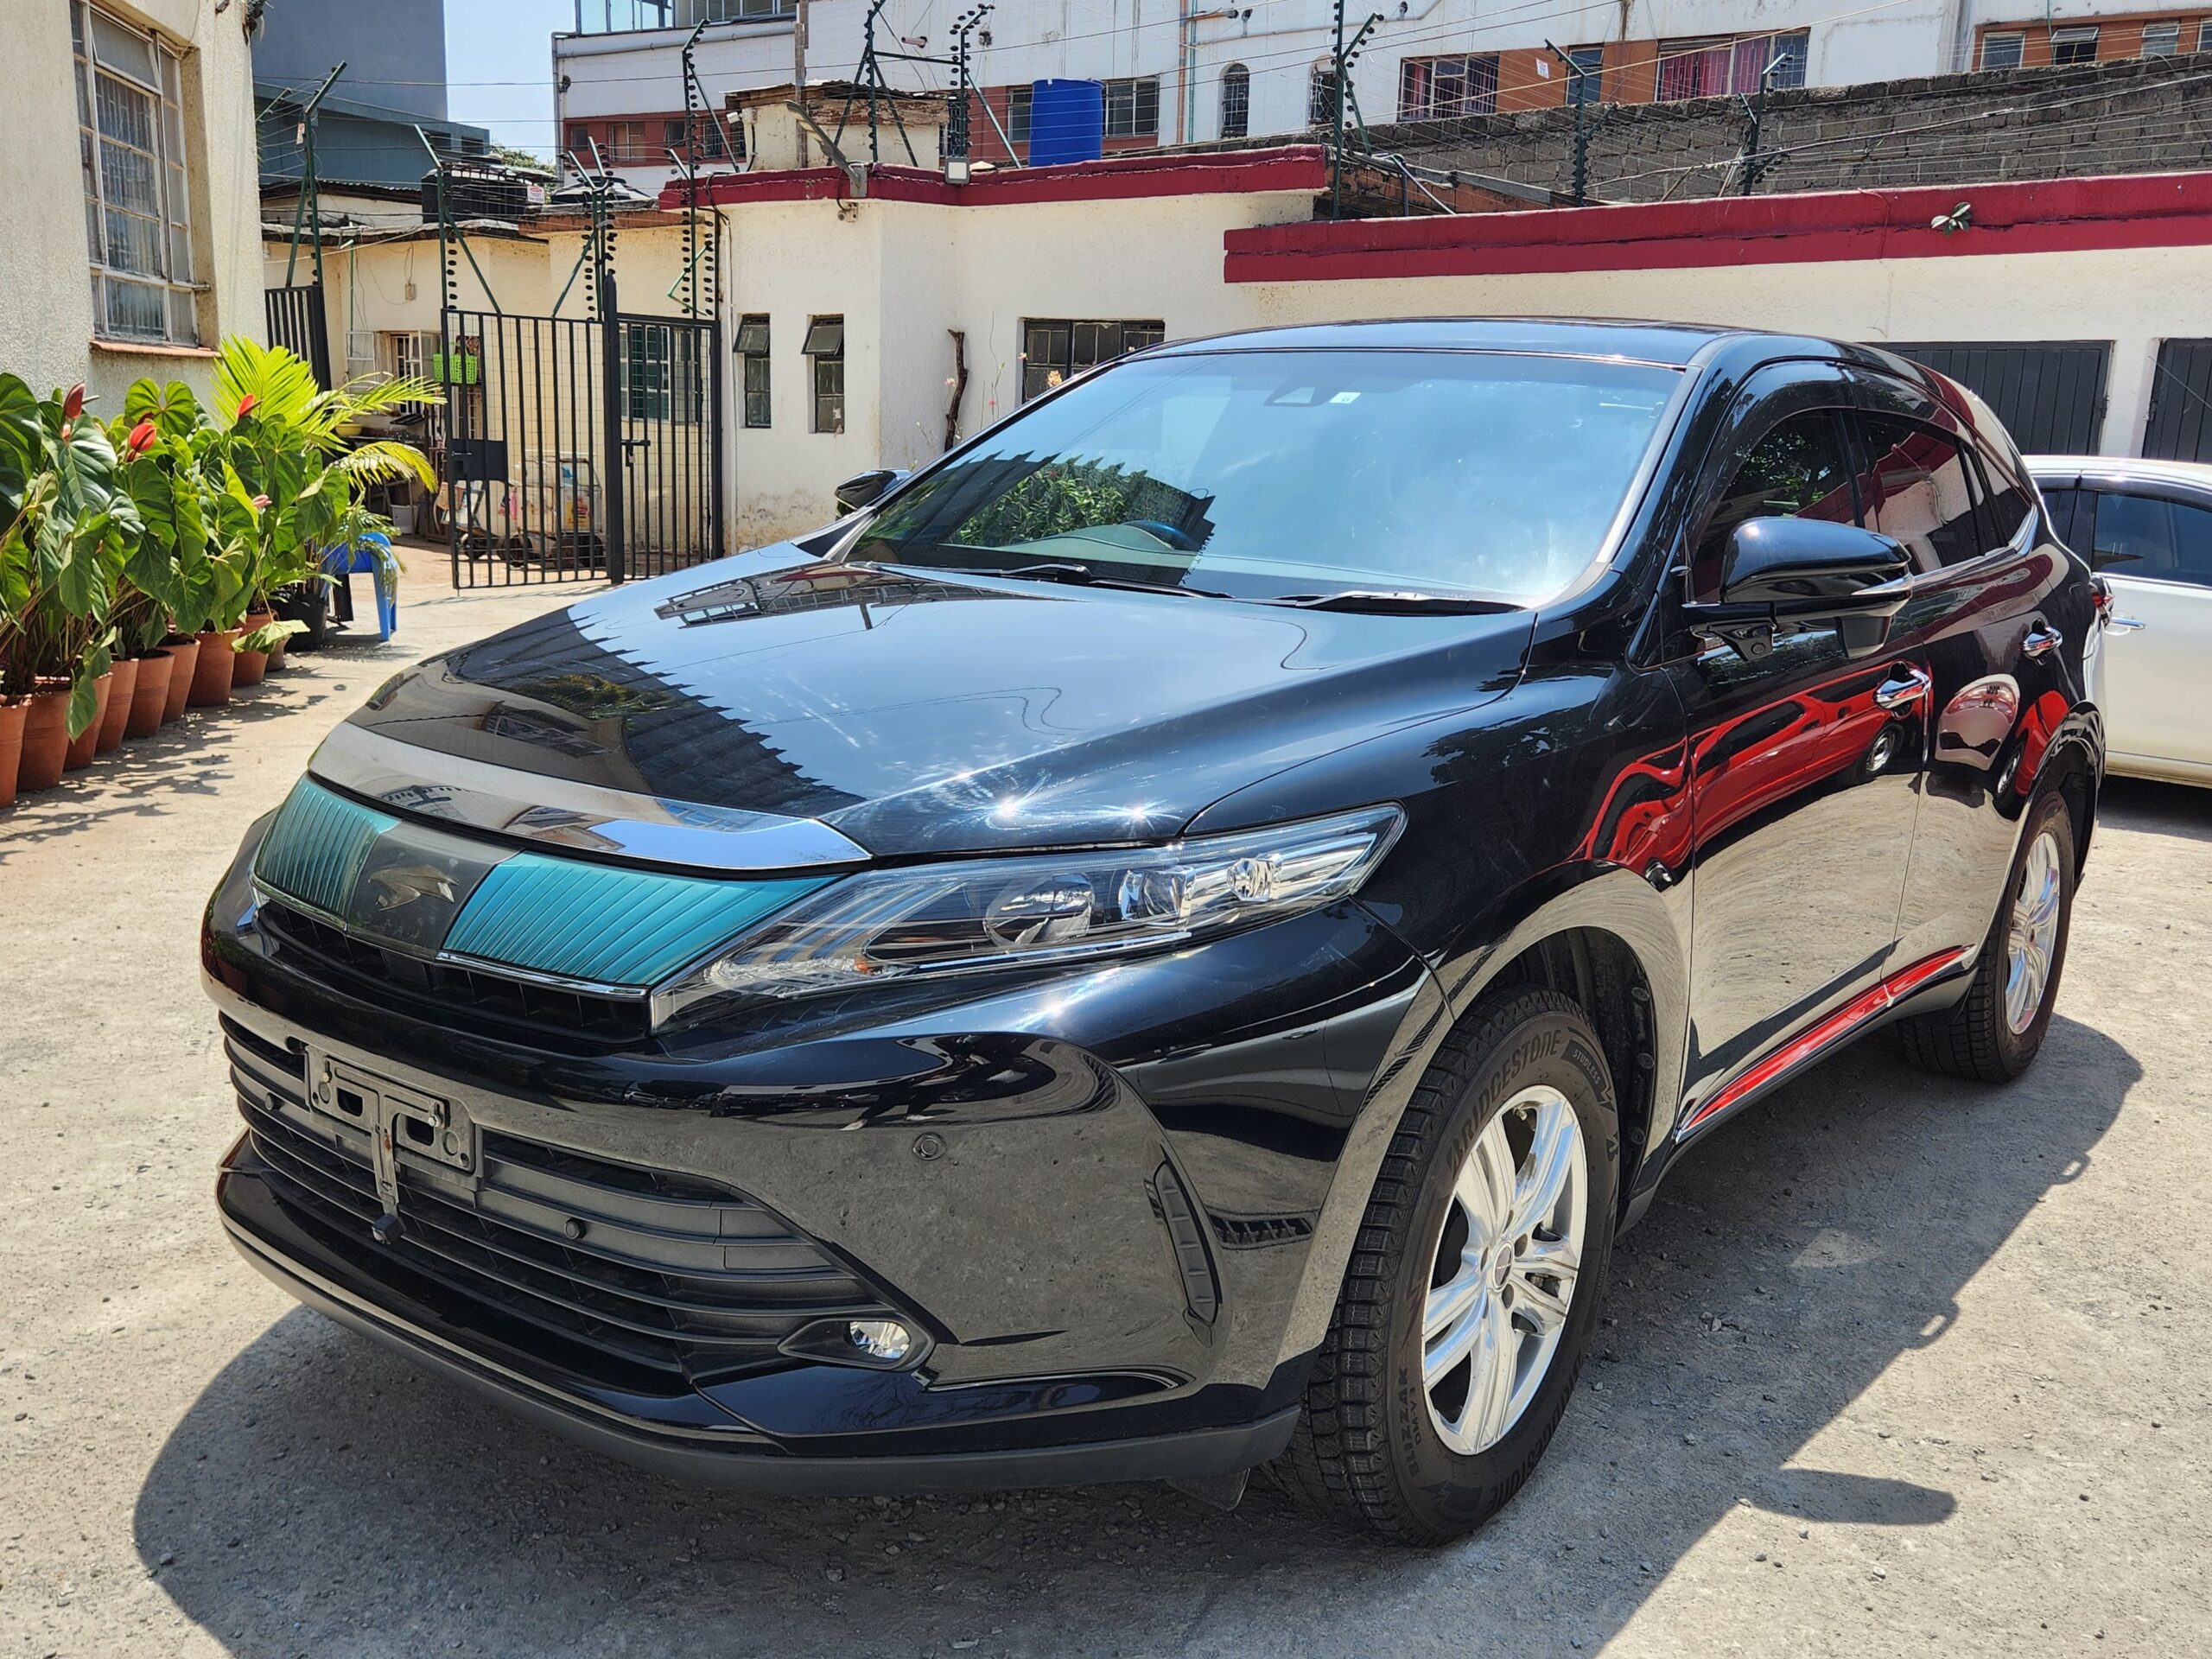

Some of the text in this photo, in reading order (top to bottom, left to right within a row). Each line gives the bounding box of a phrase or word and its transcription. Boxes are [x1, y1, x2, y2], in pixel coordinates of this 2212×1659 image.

[1446, 1029, 1561, 1185] BRIDGESTONE
[1573, 1050, 1601, 1085] STUDLESS
[1398, 1367, 1420, 1477] BLIZZAK
